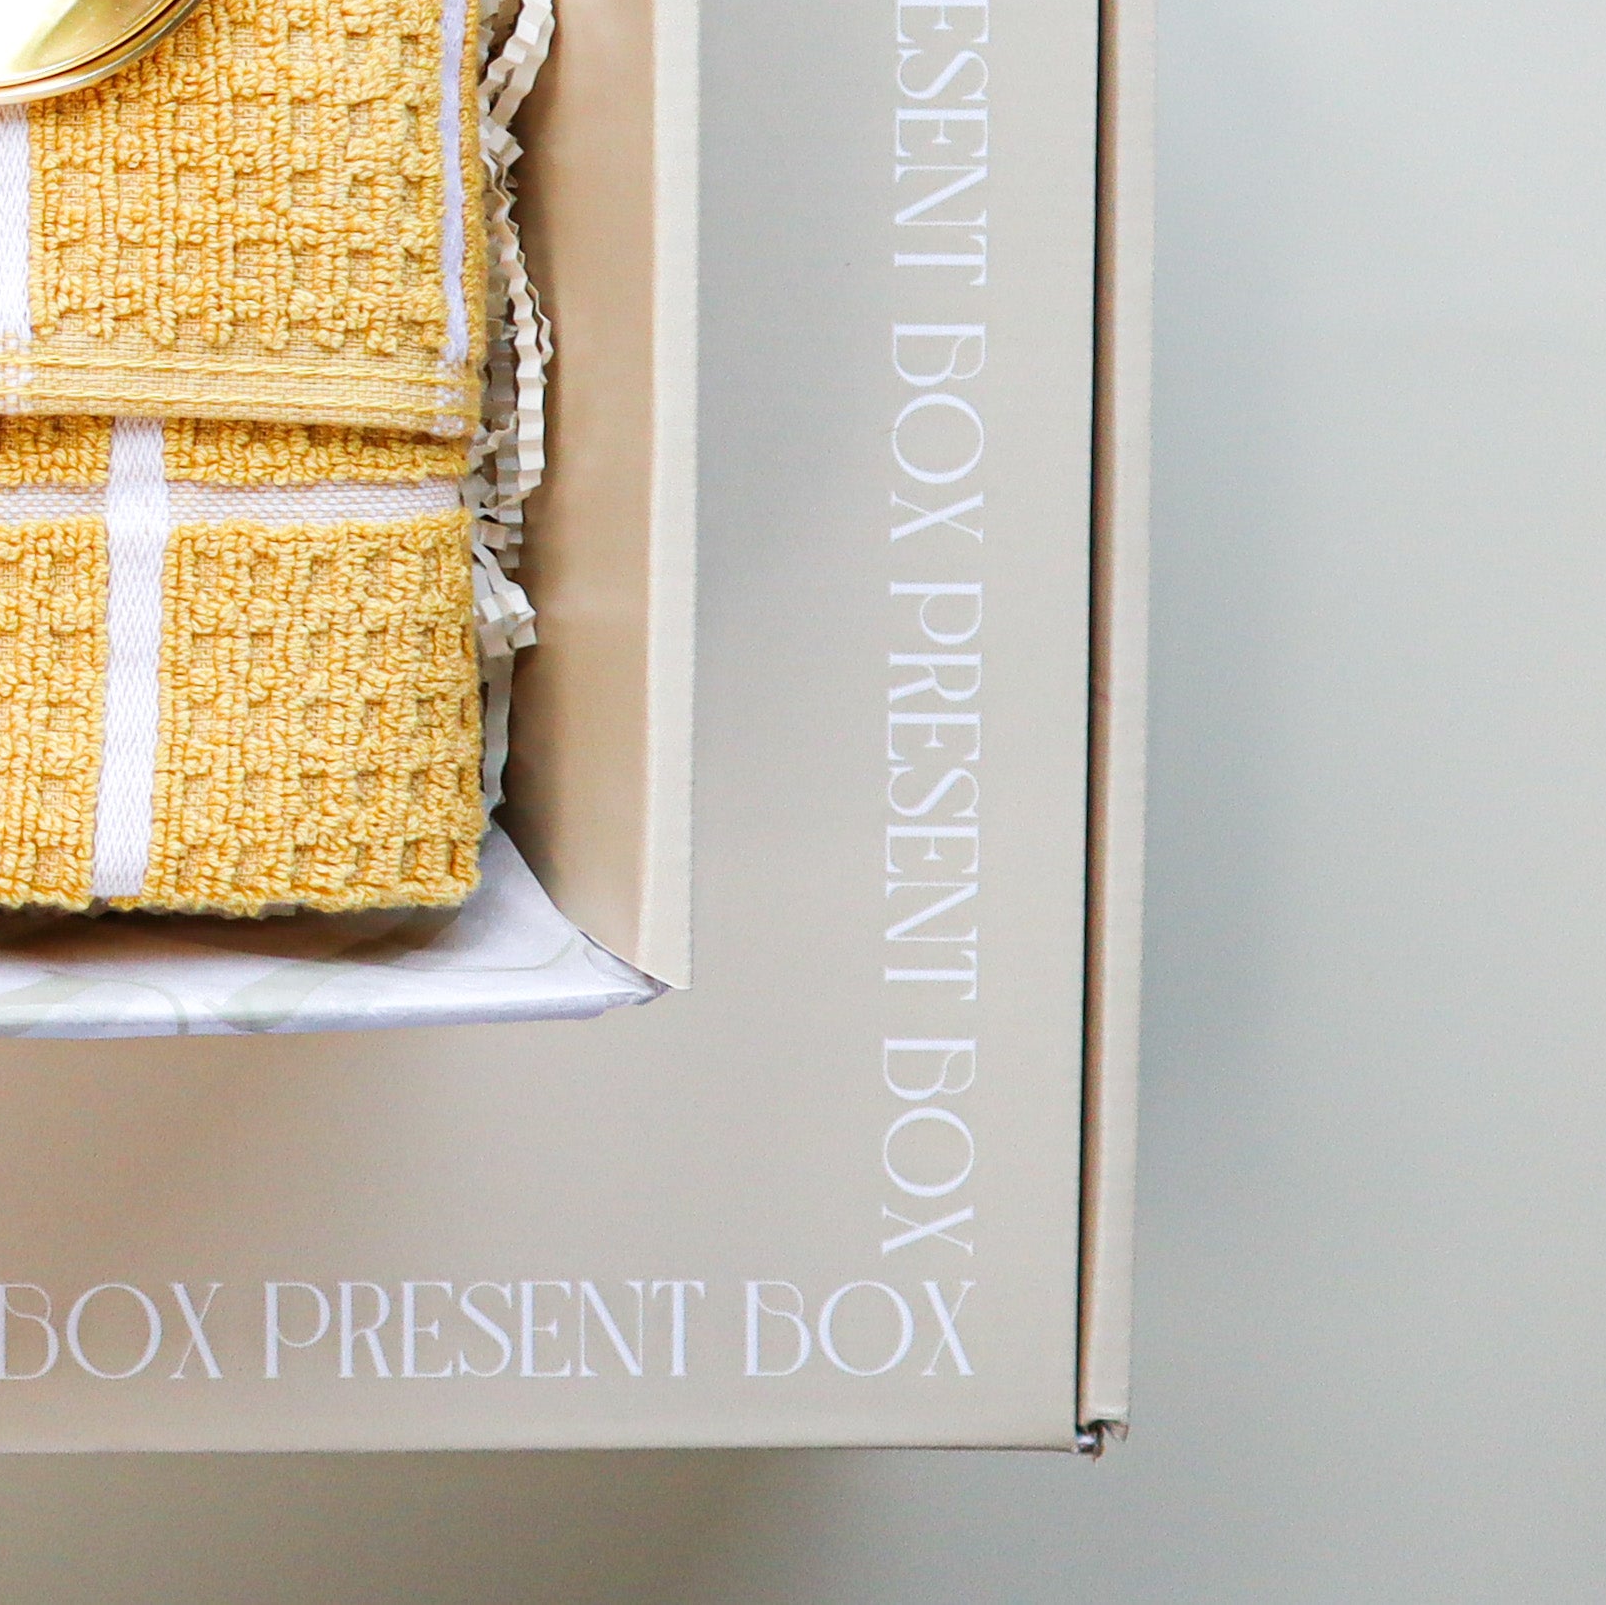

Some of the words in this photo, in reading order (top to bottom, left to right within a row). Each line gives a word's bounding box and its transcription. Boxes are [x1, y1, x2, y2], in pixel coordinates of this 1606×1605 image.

[889, 323, 987, 544] BOX
[882, 581, 984, 1002] PRESENT
[880, 1039, 978, 1257] BOX
[263, 1280, 706, 1380] PRESENT
[743, 1279, 977, 1379] BOX
